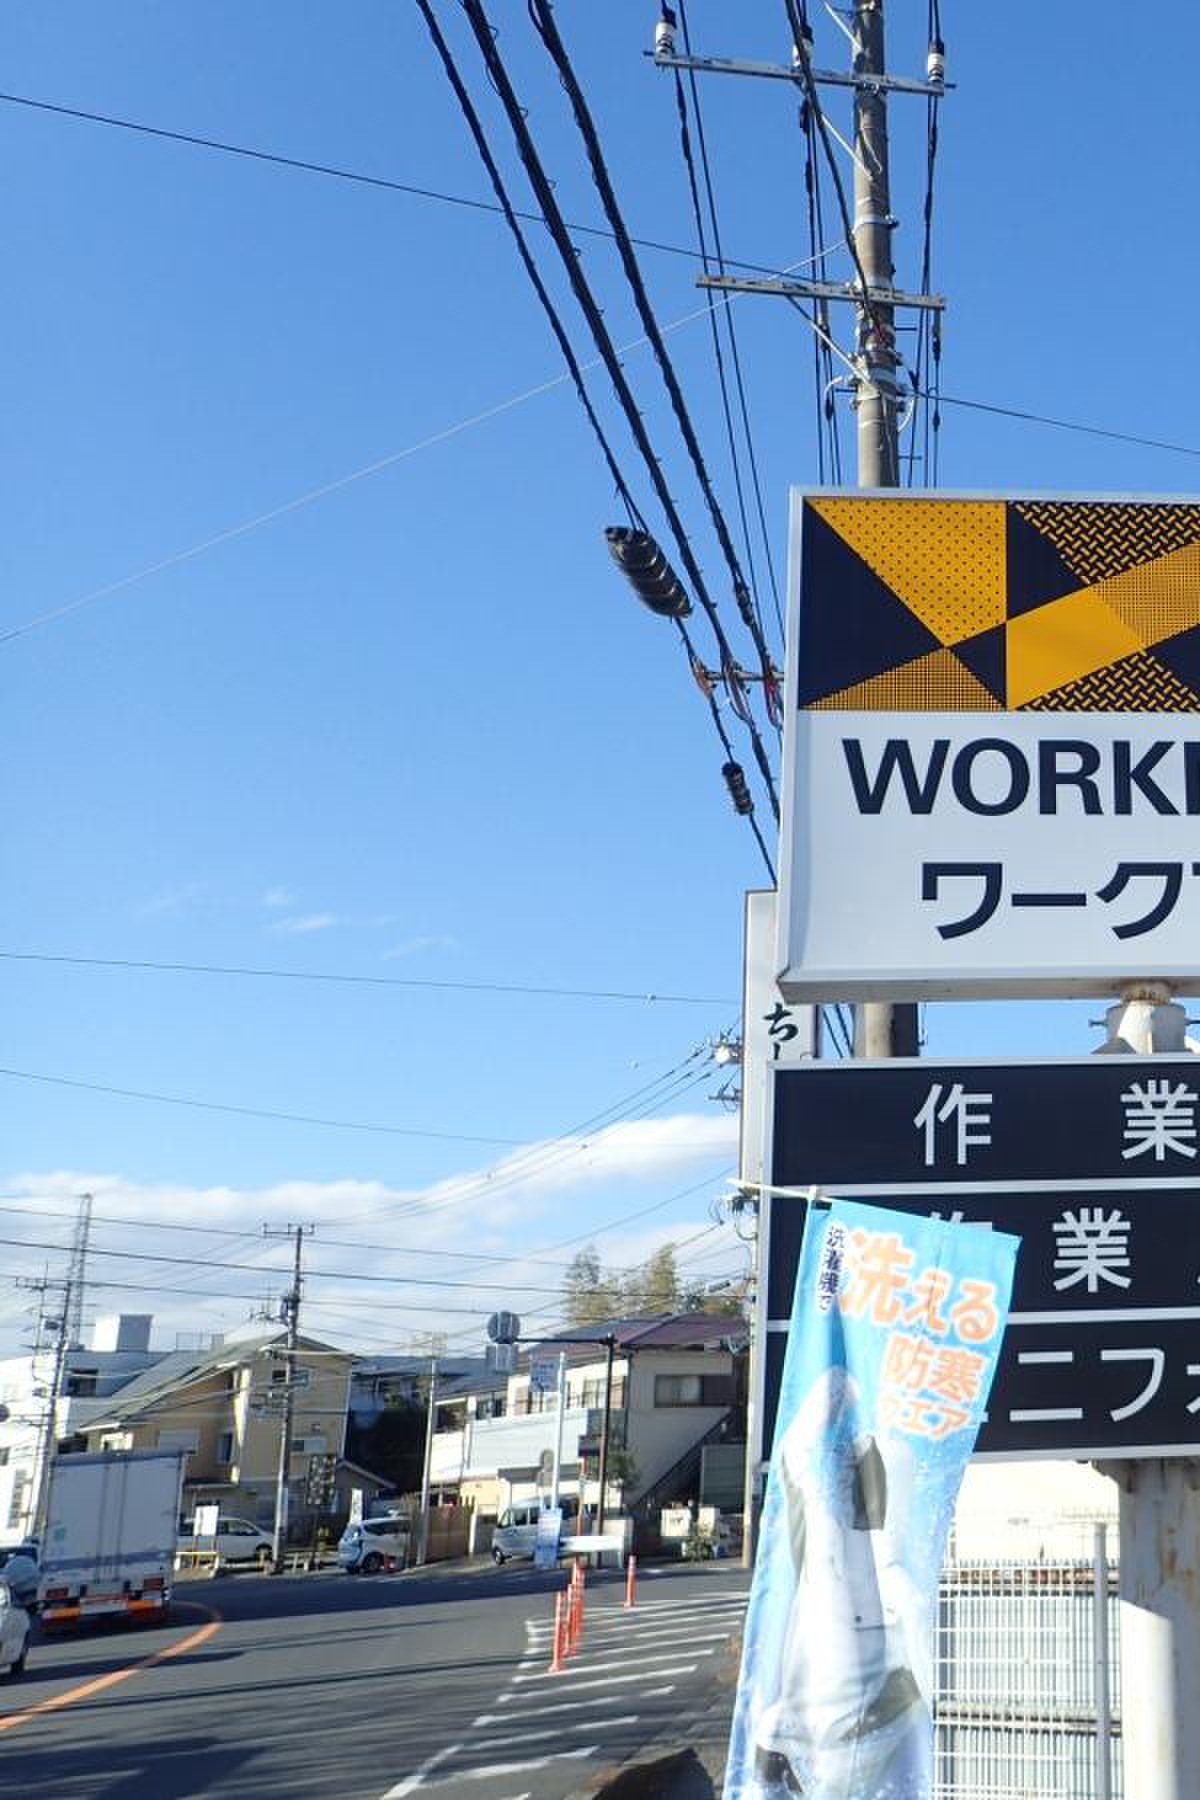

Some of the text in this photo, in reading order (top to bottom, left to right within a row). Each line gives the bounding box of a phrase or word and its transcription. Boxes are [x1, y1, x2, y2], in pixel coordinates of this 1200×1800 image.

[843, 1231, 998, 1341] 洗える
[884, 1336, 984, 1402] 防寒
